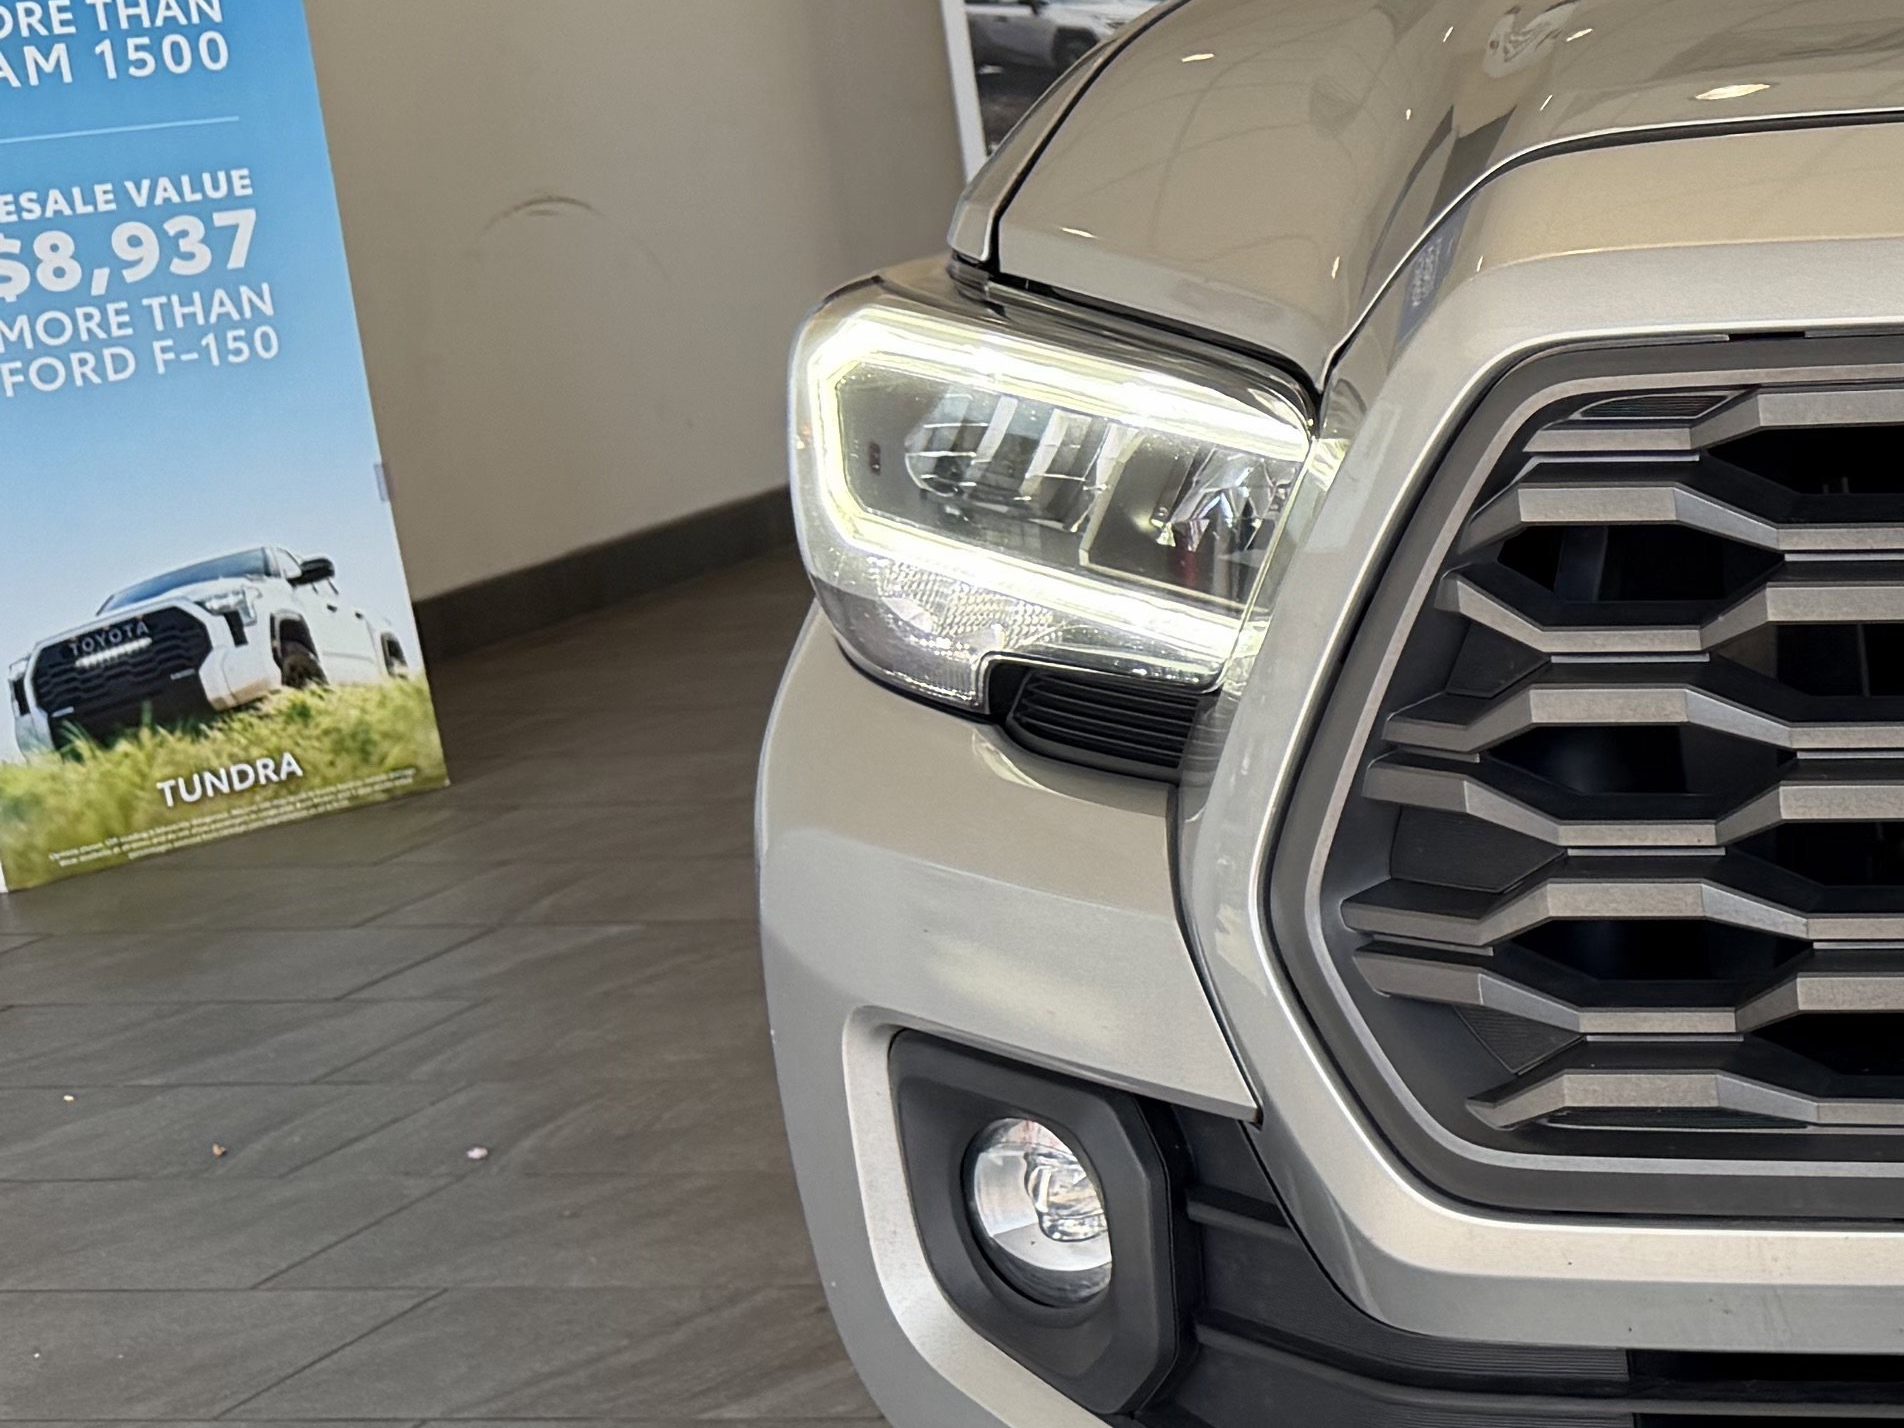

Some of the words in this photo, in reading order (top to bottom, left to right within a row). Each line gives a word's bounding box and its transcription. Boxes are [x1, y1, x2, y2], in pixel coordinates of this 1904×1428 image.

[94, 30, 228, 79] 1500
[124, 168, 253, 208] VALUE
[0, 208, 256, 303] $8,937
[0, 301, 134, 354] MORE
[142, 282, 274, 332] THAN
[0, 346, 136, 398] FORD
[152, 324, 279, 374] F-150
[69, 620, 149, 657] TOYOTA
[156, 752, 303, 808] TUNDRA
